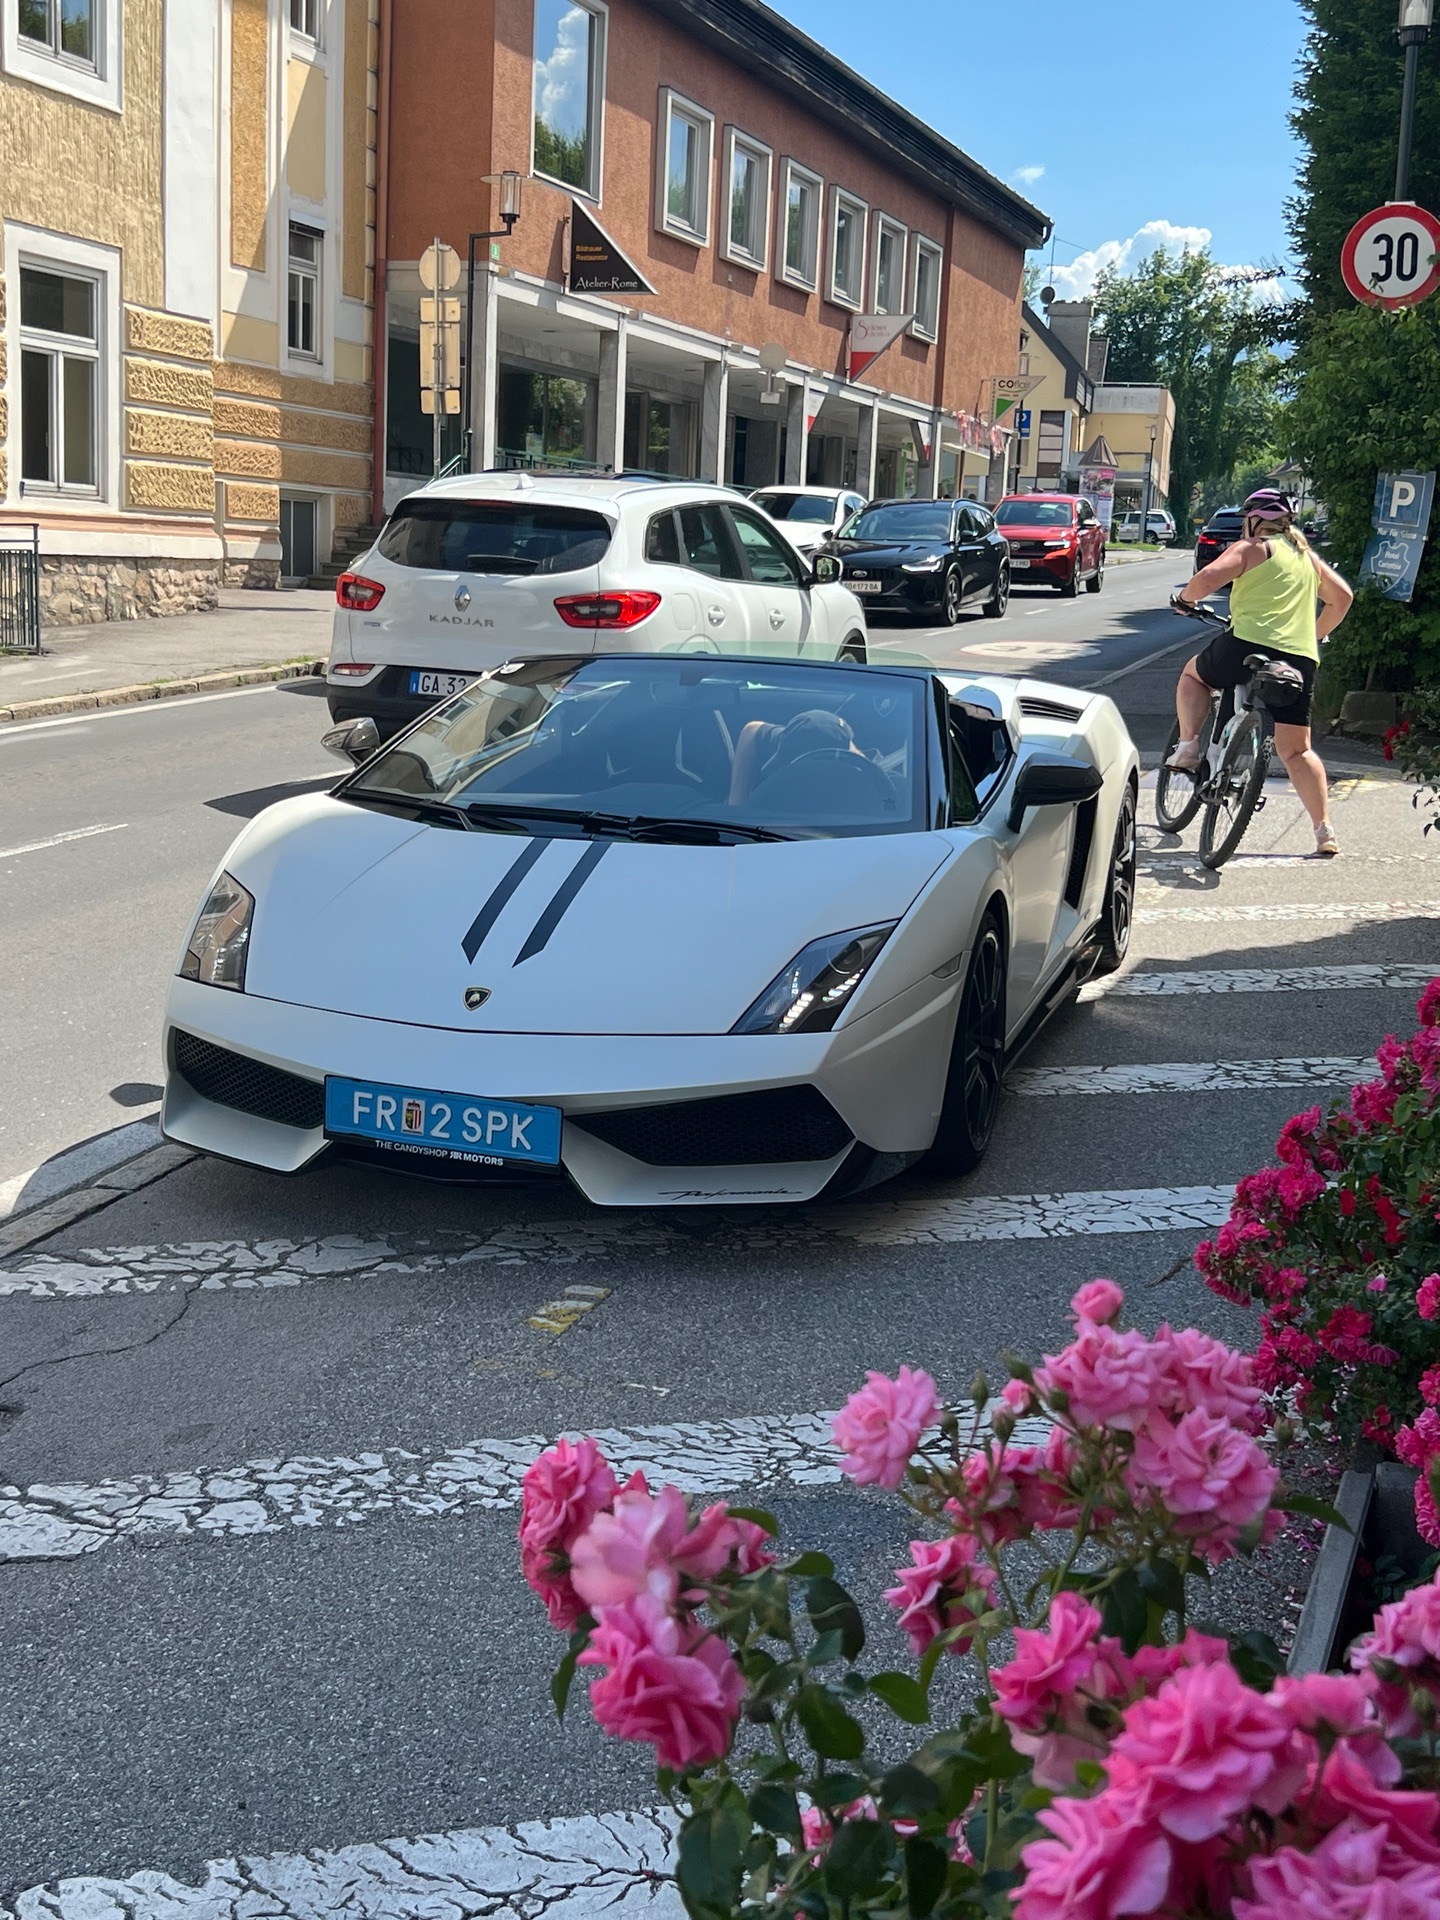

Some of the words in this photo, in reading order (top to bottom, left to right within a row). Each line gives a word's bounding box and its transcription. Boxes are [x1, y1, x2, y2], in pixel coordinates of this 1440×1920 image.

[1371, 232, 1419, 282] 30
[575, 276, 638, 290] Atelier-Rome
[1389, 480, 1415, 518] P
[429, 614, 494, 628] KADJAR
[421, 674, 439, 694] GA
[353, 1091, 398, 1131] FR
[429, 1102, 452, 1139] 2
[461, 1106, 534, 1151] SPK
[375, 1140, 393, 1150] THE
[393, 1143, 448, 1158] CANDYSHOP
[463, 1153, 504, 1167] MOTORS
